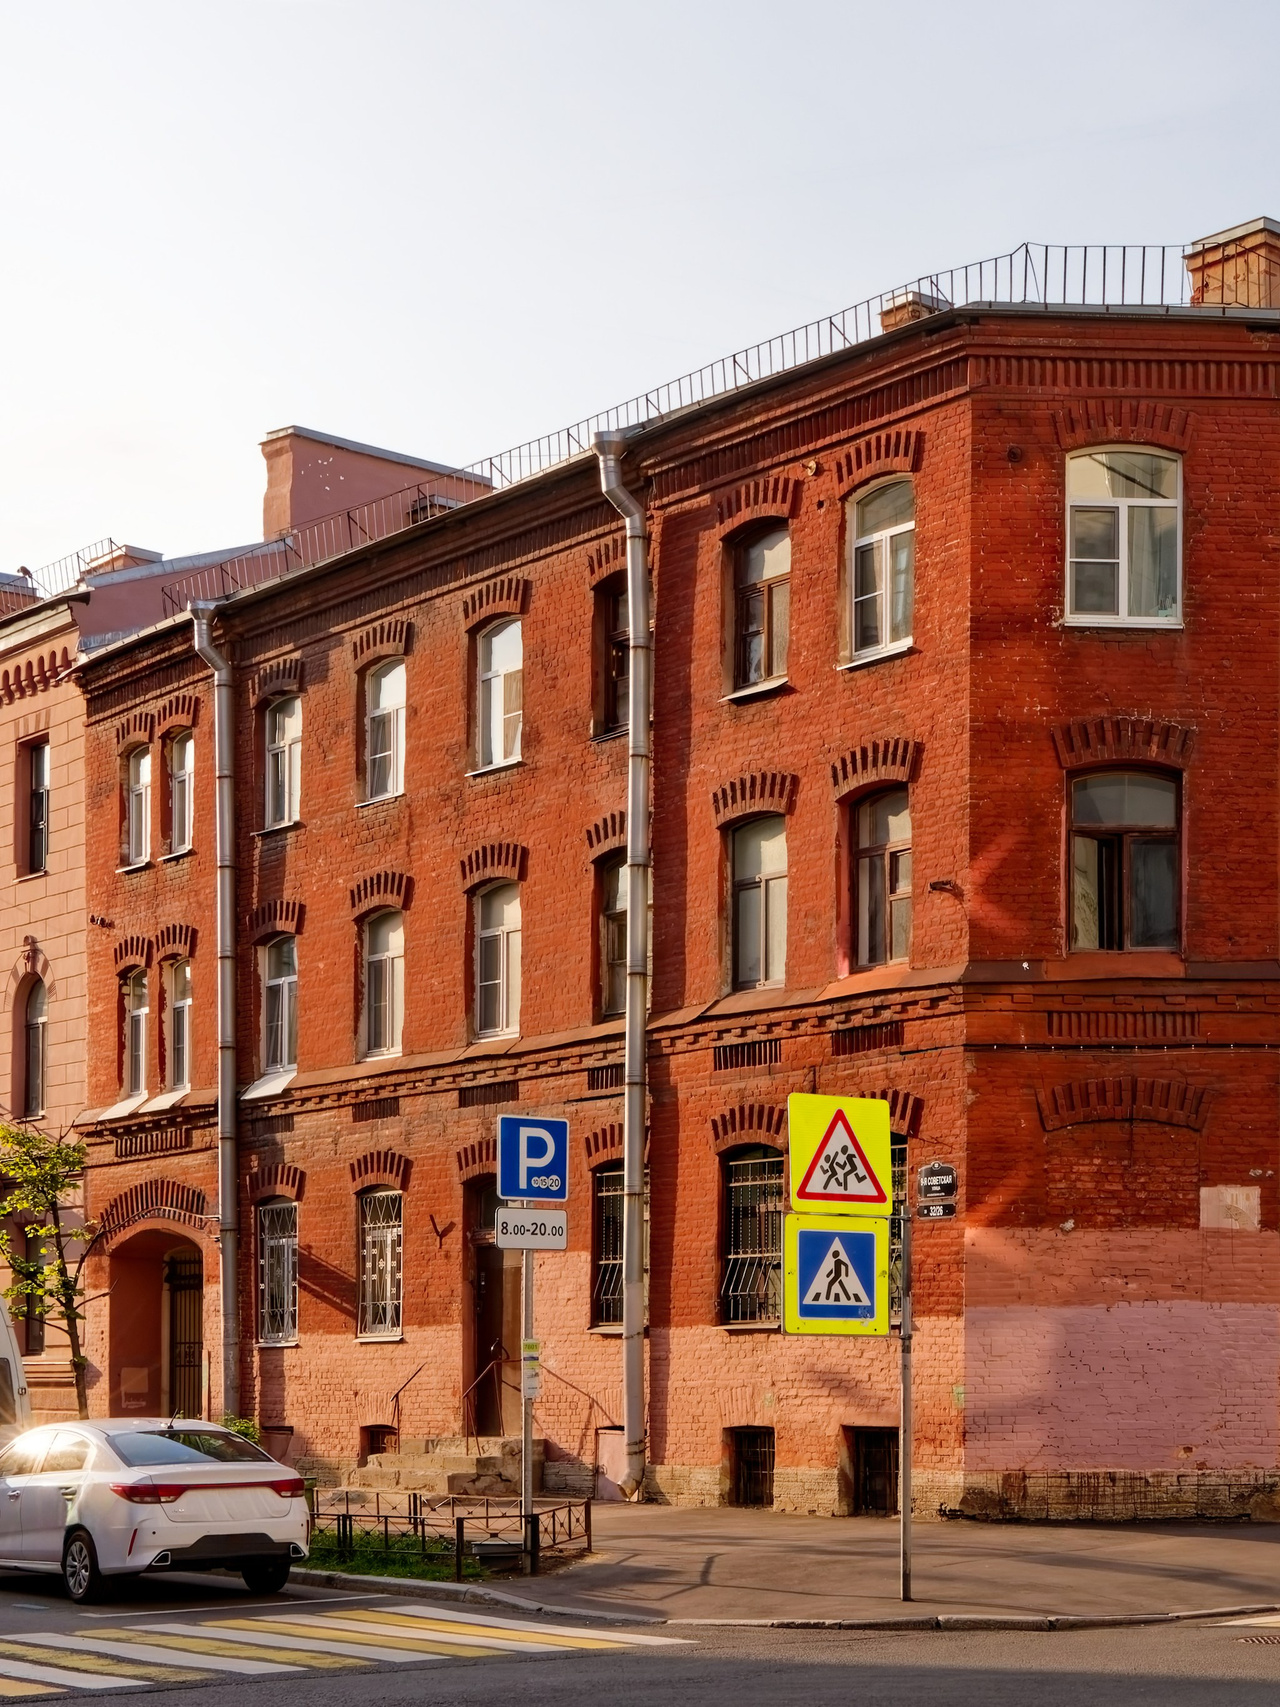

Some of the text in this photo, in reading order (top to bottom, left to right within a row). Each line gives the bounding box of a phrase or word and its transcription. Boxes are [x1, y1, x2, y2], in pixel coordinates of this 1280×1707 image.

[519, 1127, 555, 1189] P
[540, 1178, 547, 1187] 15
[549, 1178, 560, 1188] 20
[501, 1222, 563, 1236] 8.00-20.00
